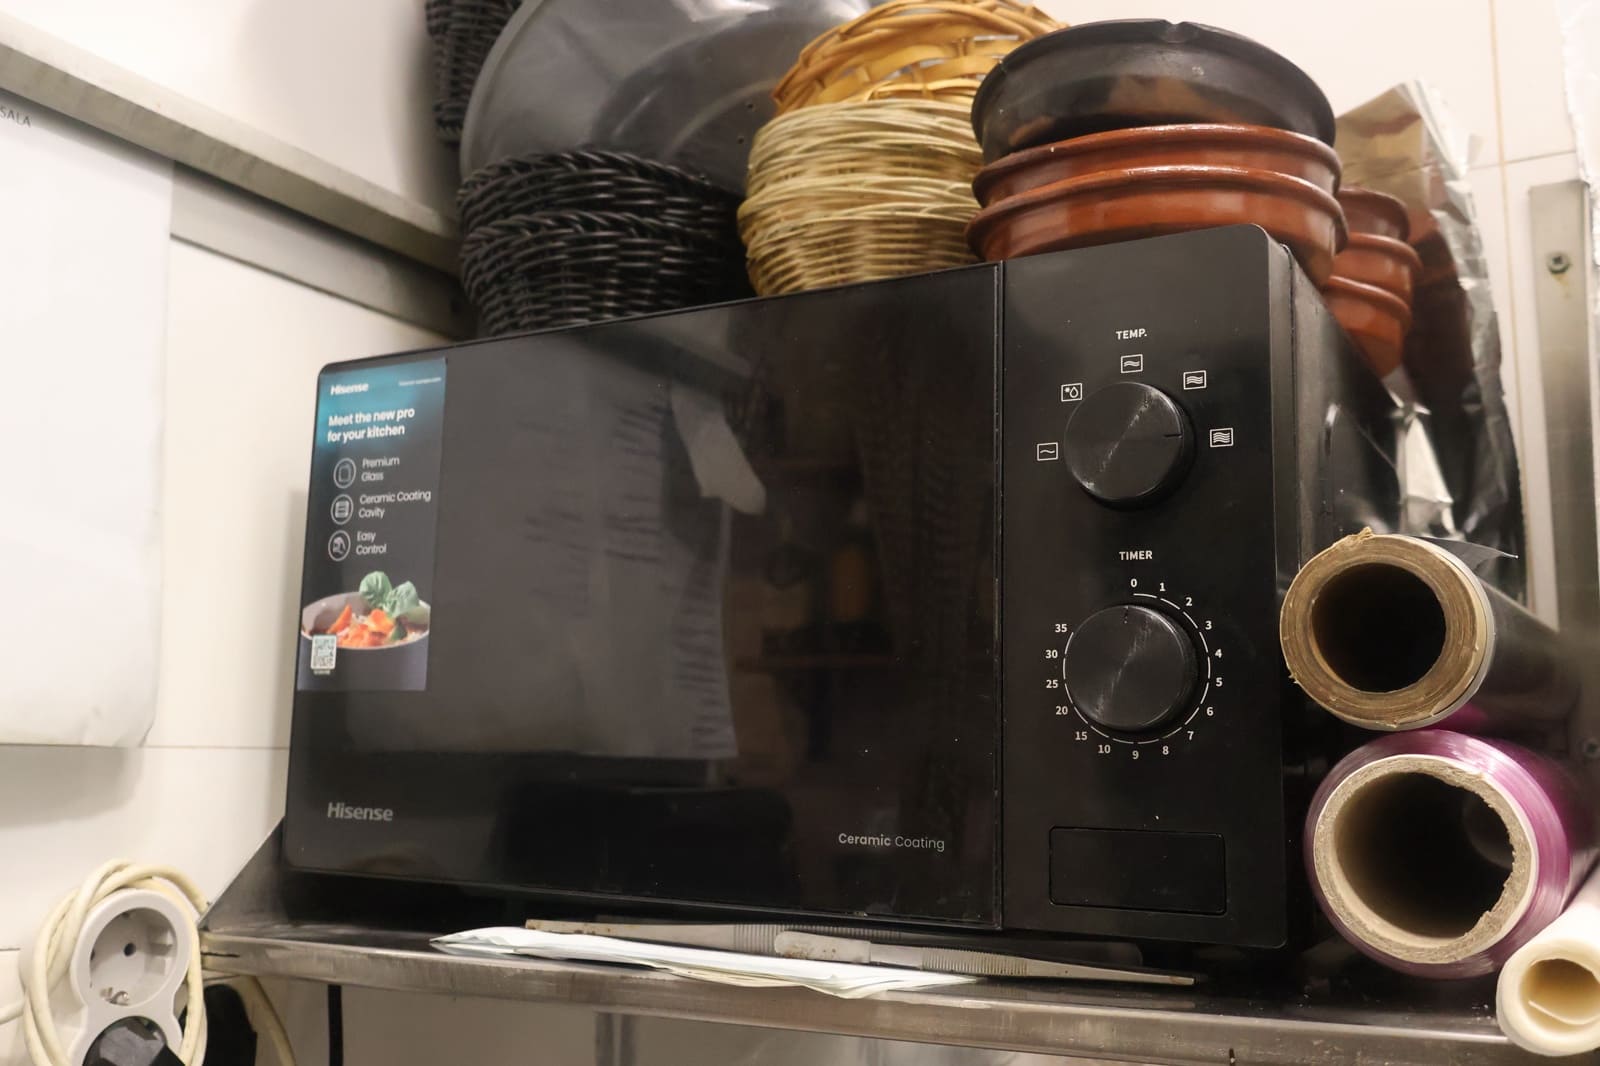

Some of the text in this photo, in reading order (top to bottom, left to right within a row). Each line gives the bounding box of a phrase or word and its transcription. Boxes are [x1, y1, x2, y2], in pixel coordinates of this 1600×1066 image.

[1116, 328, 1148, 340] TEMP.
[330, 383, 369, 395] Hisense
[328, 408, 415, 427] Meet the new pro
[327, 425, 405, 444] for your kitchen
[362, 456, 400, 469] Premium
[361, 472, 384, 482] Glass
[360, 490, 431, 504] Ceramic Coating
[358, 508, 385, 519] Cavity
[356, 531, 376, 542] Easy
[355, 544, 387, 555] Control
[1119, 550, 1153, 561] TIMER
[1130, 578, 1138, 588] 0
[1159, 582, 1166, 592] 1
[1185, 597, 1193, 607] 2
[1055, 624, 1068, 633] 35
[1205, 621, 1212, 630] 3
[1045, 650, 1058, 659] 30
[1215, 649, 1223, 659] 4
[1046, 680, 1059, 689] 25
[1215, 677, 1223, 687] 5
[1055, 706, 1068, 715] 20
[1206, 706, 1214, 716] 6
[1075, 731, 1088, 741] 15
[1187, 731, 1194, 741] 7
[1098, 745, 1111, 754] 10
[1162, 746, 1170, 755] 8
[1132, 750, 1139, 760] 9
[327, 802, 393, 821] Hisense
[838, 833, 945, 852] Ceramic Coating
